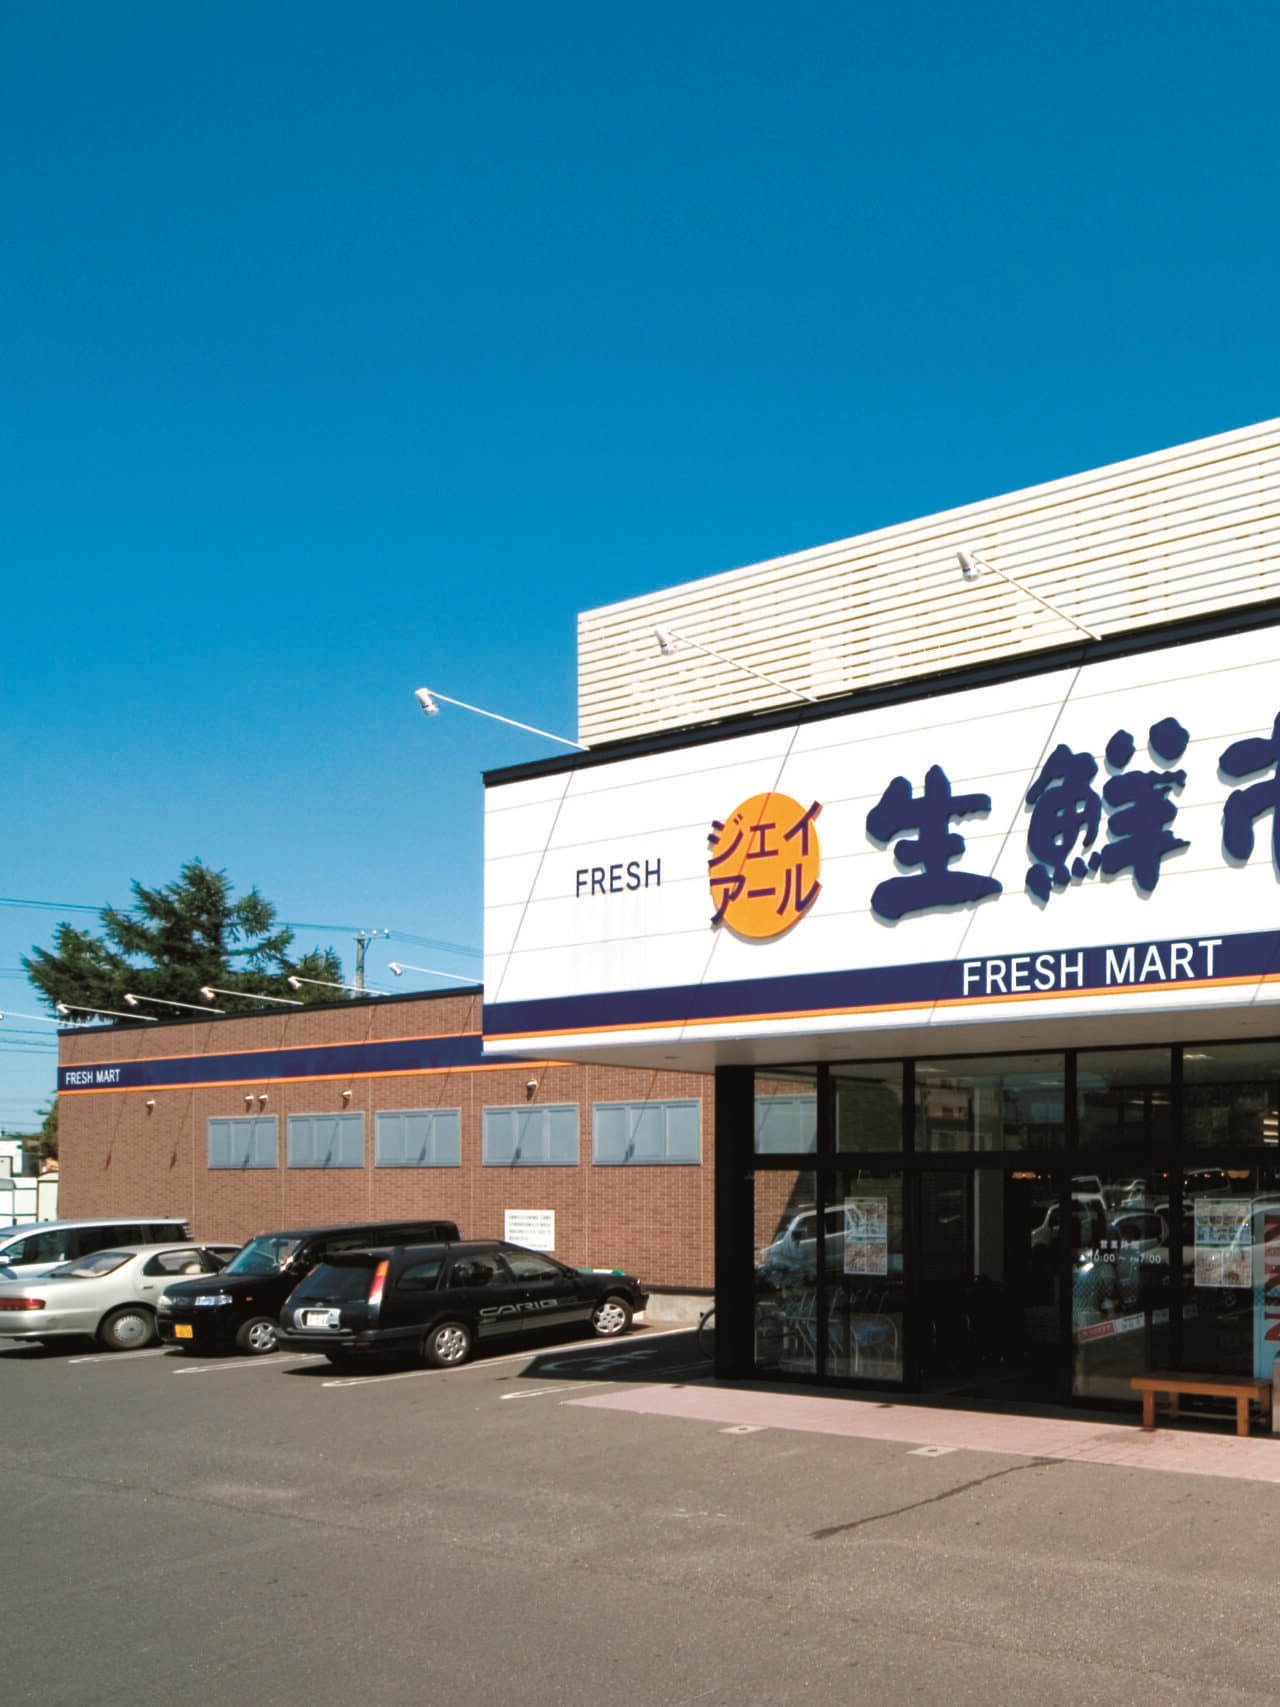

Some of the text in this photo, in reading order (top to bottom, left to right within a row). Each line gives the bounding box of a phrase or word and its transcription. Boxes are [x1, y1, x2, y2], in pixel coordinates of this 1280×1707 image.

[708, 800, 823, 868] ジェイ
[576, 858, 662, 898] FRESH
[709, 863, 823, 925] アール
[963, 939, 1223, 996] FRESH MART
[65, 1069, 120, 1085] FRESH MART
